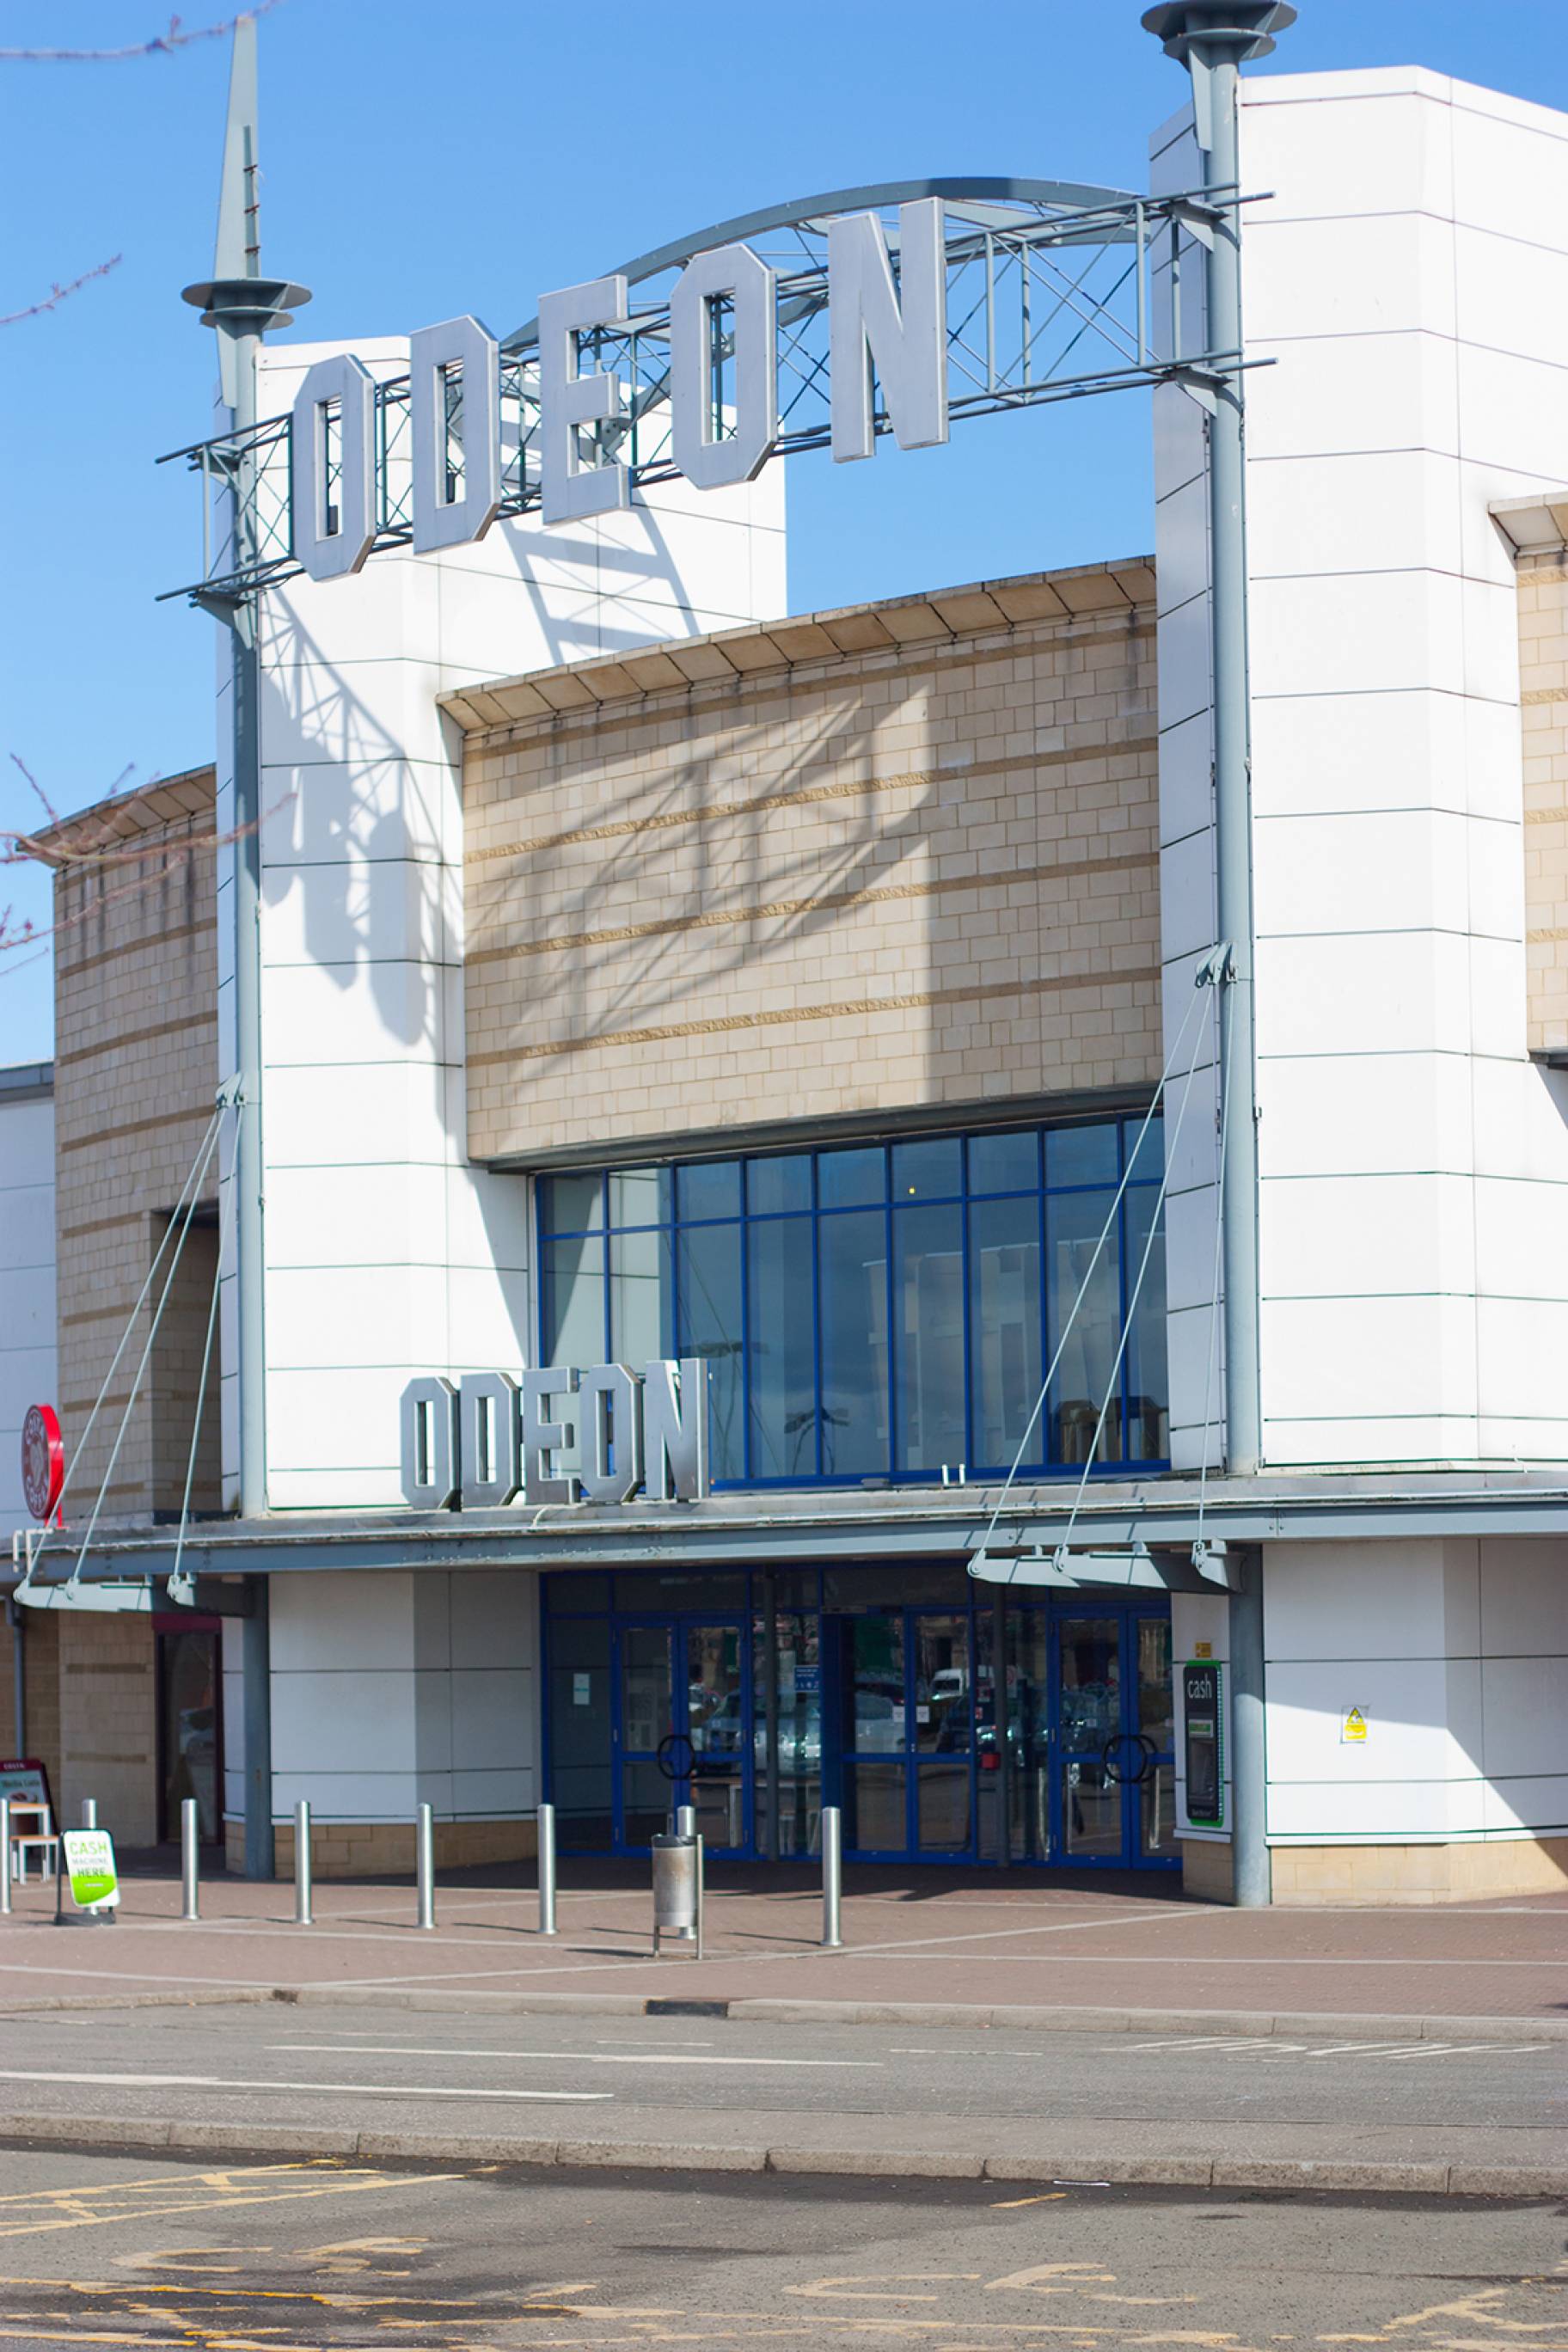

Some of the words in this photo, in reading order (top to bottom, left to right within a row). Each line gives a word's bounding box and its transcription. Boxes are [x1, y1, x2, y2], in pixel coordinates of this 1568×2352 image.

[293, 196, 949, 582] ODEON
[401, 1358, 709, 1510] ODEON
[1187, 1673, 1212, 1699] cash
[69, 1841, 108, 1855] CASH
[77, 1867, 107, 1878] HERE
